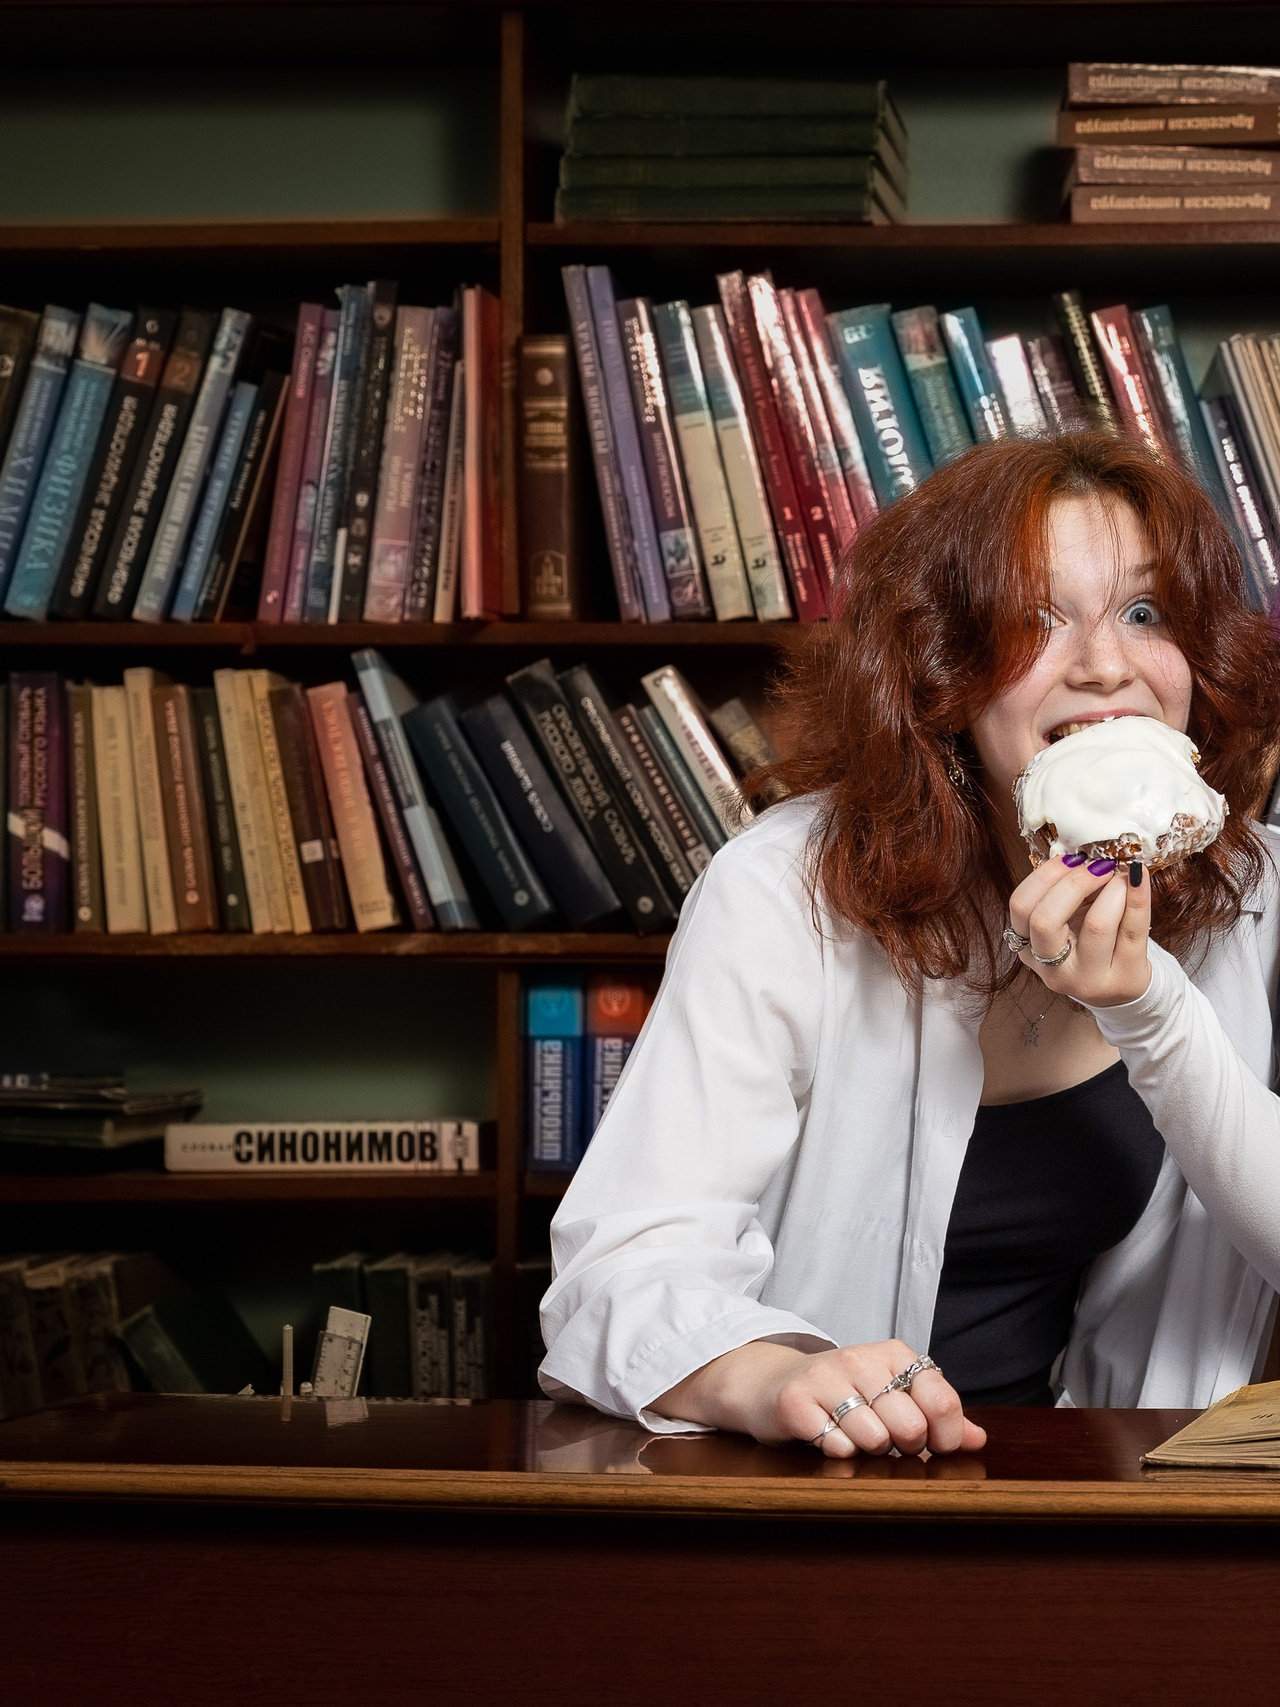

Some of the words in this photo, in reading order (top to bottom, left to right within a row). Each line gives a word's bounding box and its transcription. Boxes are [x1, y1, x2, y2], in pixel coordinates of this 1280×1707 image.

[130, 348, 151, 378] 1
[858, 362, 914, 492] ЛОГИЯ
[24, 451, 80, 575] ФИЗИКА
[783, 507, 793, 520] 1
[811, 507, 824, 521] 2
[34, 687, 46, 734] ЯЗЫКА
[535, 709, 578, 775] РУССКОГО
[34, 736, 47, 807] РУССКОГО
[601, 806, 639, 865] СЛОВАРЬ
[233, 1131, 438, 1163] СИНОНИМОВ
